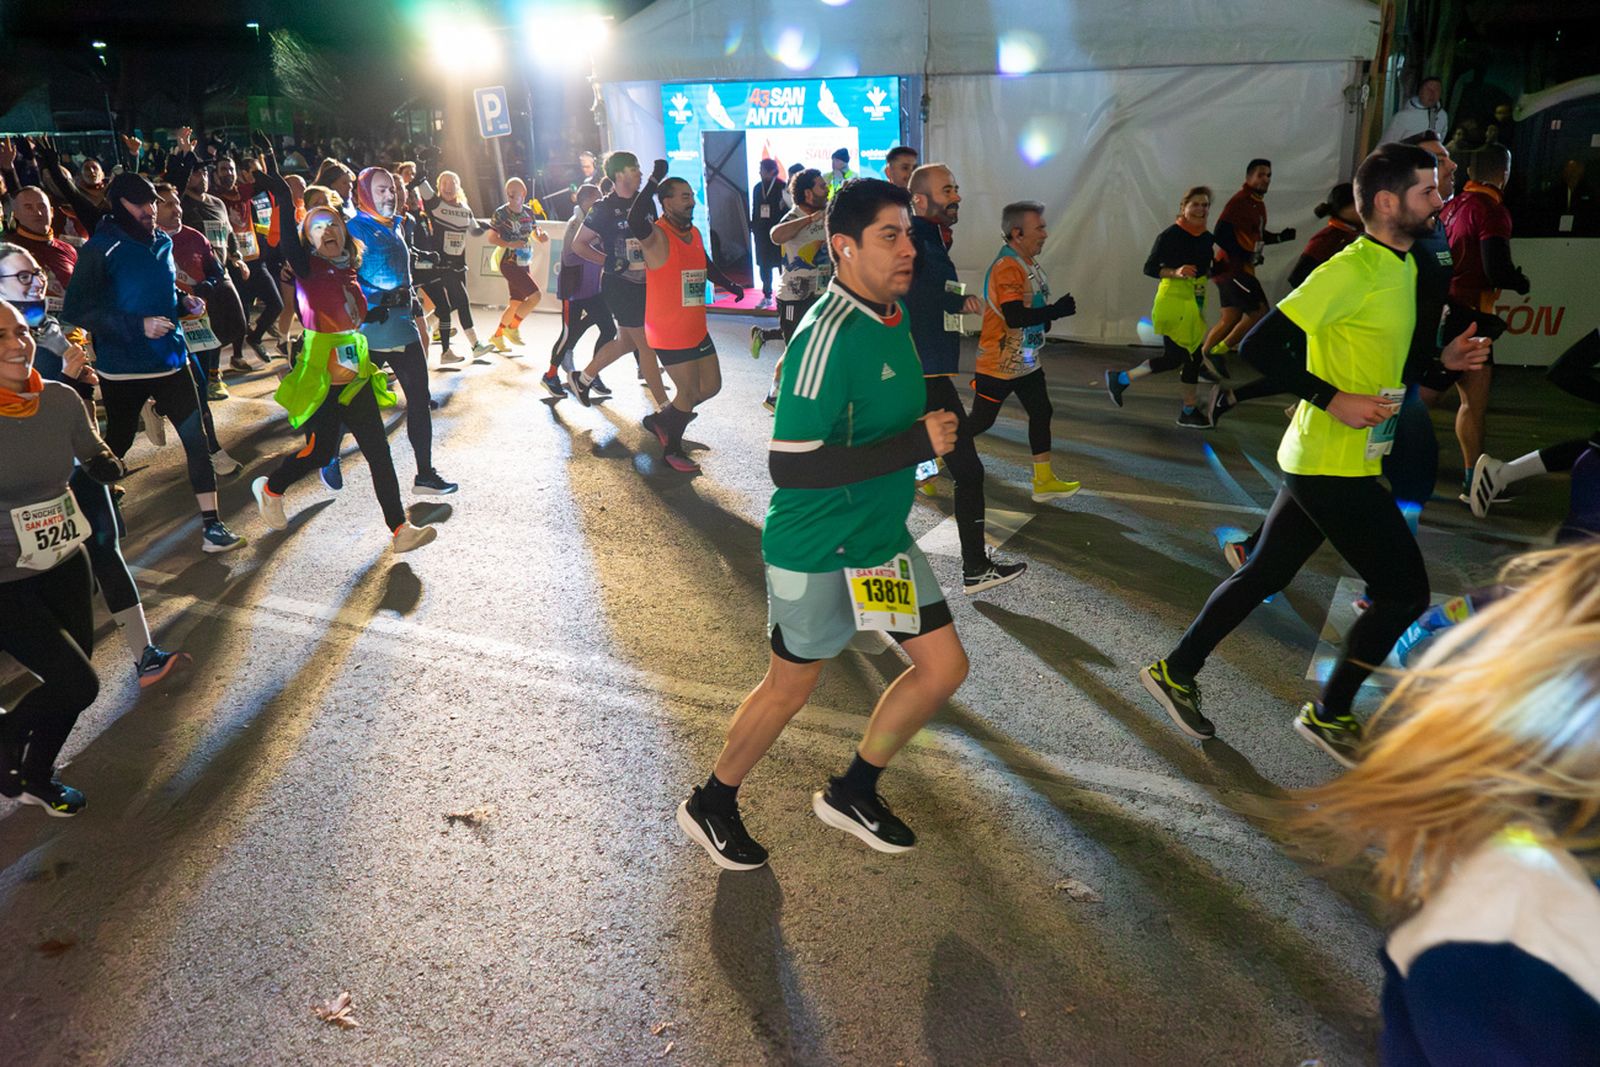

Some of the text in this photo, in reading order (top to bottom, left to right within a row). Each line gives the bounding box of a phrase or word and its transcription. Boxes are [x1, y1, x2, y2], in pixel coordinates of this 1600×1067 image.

[749, 86, 806, 107] 43 SAN
[482, 93, 501, 131] P
[745, 103, 804, 126] ANTÓN
[32, 508, 57, 519] NOCHE
[25, 520, 41, 532] SAN
[35, 519, 80, 551] 5242
[856, 569, 873, 577] SAN
[862, 578, 910, 605] 13812
